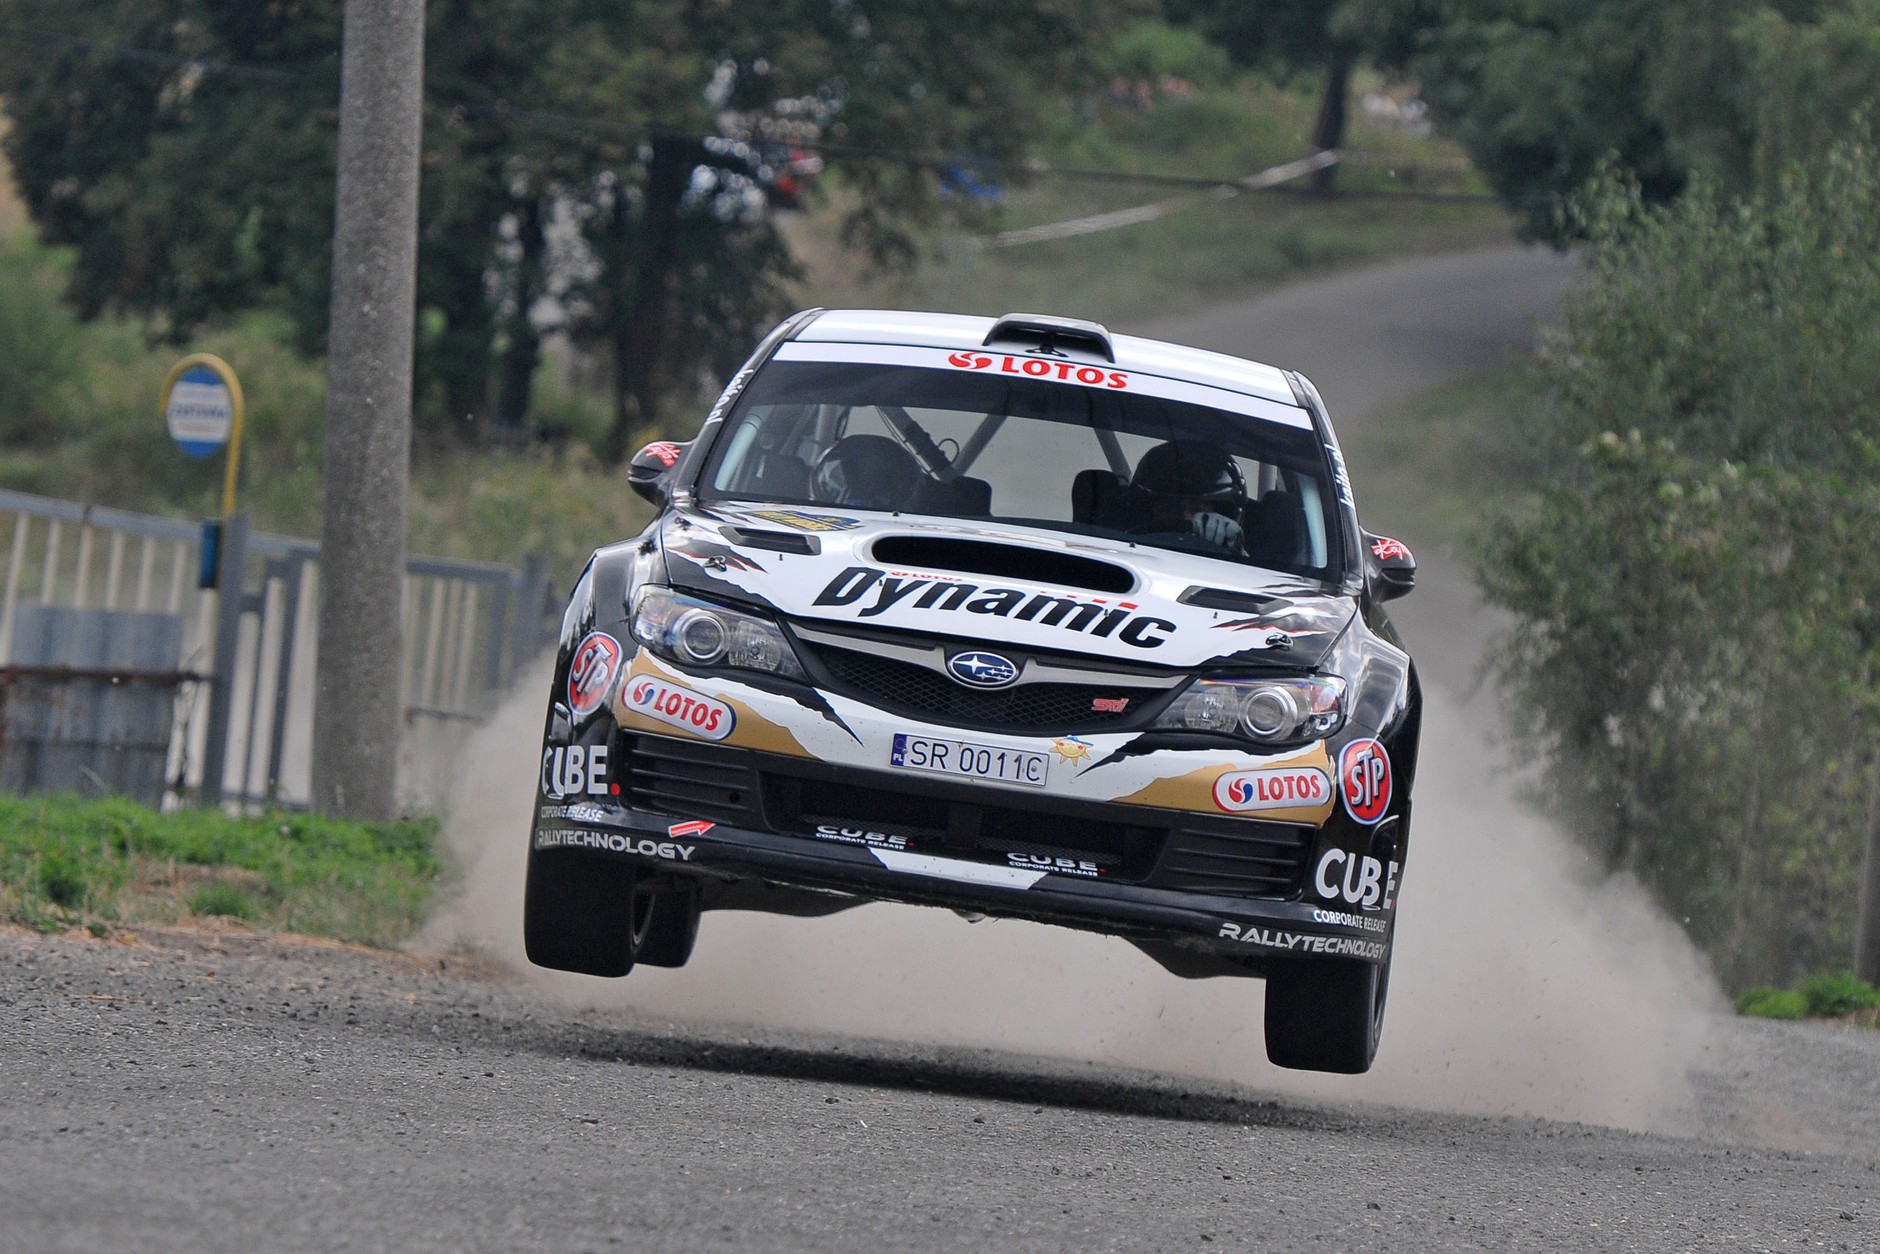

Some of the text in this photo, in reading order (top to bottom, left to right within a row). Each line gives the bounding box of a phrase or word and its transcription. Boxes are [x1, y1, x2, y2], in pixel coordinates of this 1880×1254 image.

[1002, 356, 1128, 389] LOTOS
[811, 566, 1177, 648] Dynamic
[572, 643, 612, 696] STP
[654, 688, 723, 731] LOTOS
[892, 753, 903, 762] PL
[910, 740, 1043, 782] SR 0011C
[1257, 774, 1322, 801] LOTOS
[1351, 748, 1385, 807] STP
[566, 805, 604, 822] RELEASE
[537, 829, 696, 861] RALLYTECHNOLOGY
[815, 832, 905, 850] CORPORATE RELEASE
[1008, 860, 1098, 877] CORPORATE RELEASE
[1313, 909, 1387, 933] CORPORATE RELEASE
[1219, 922, 1386, 960] RALLYTECHNOLOGY
